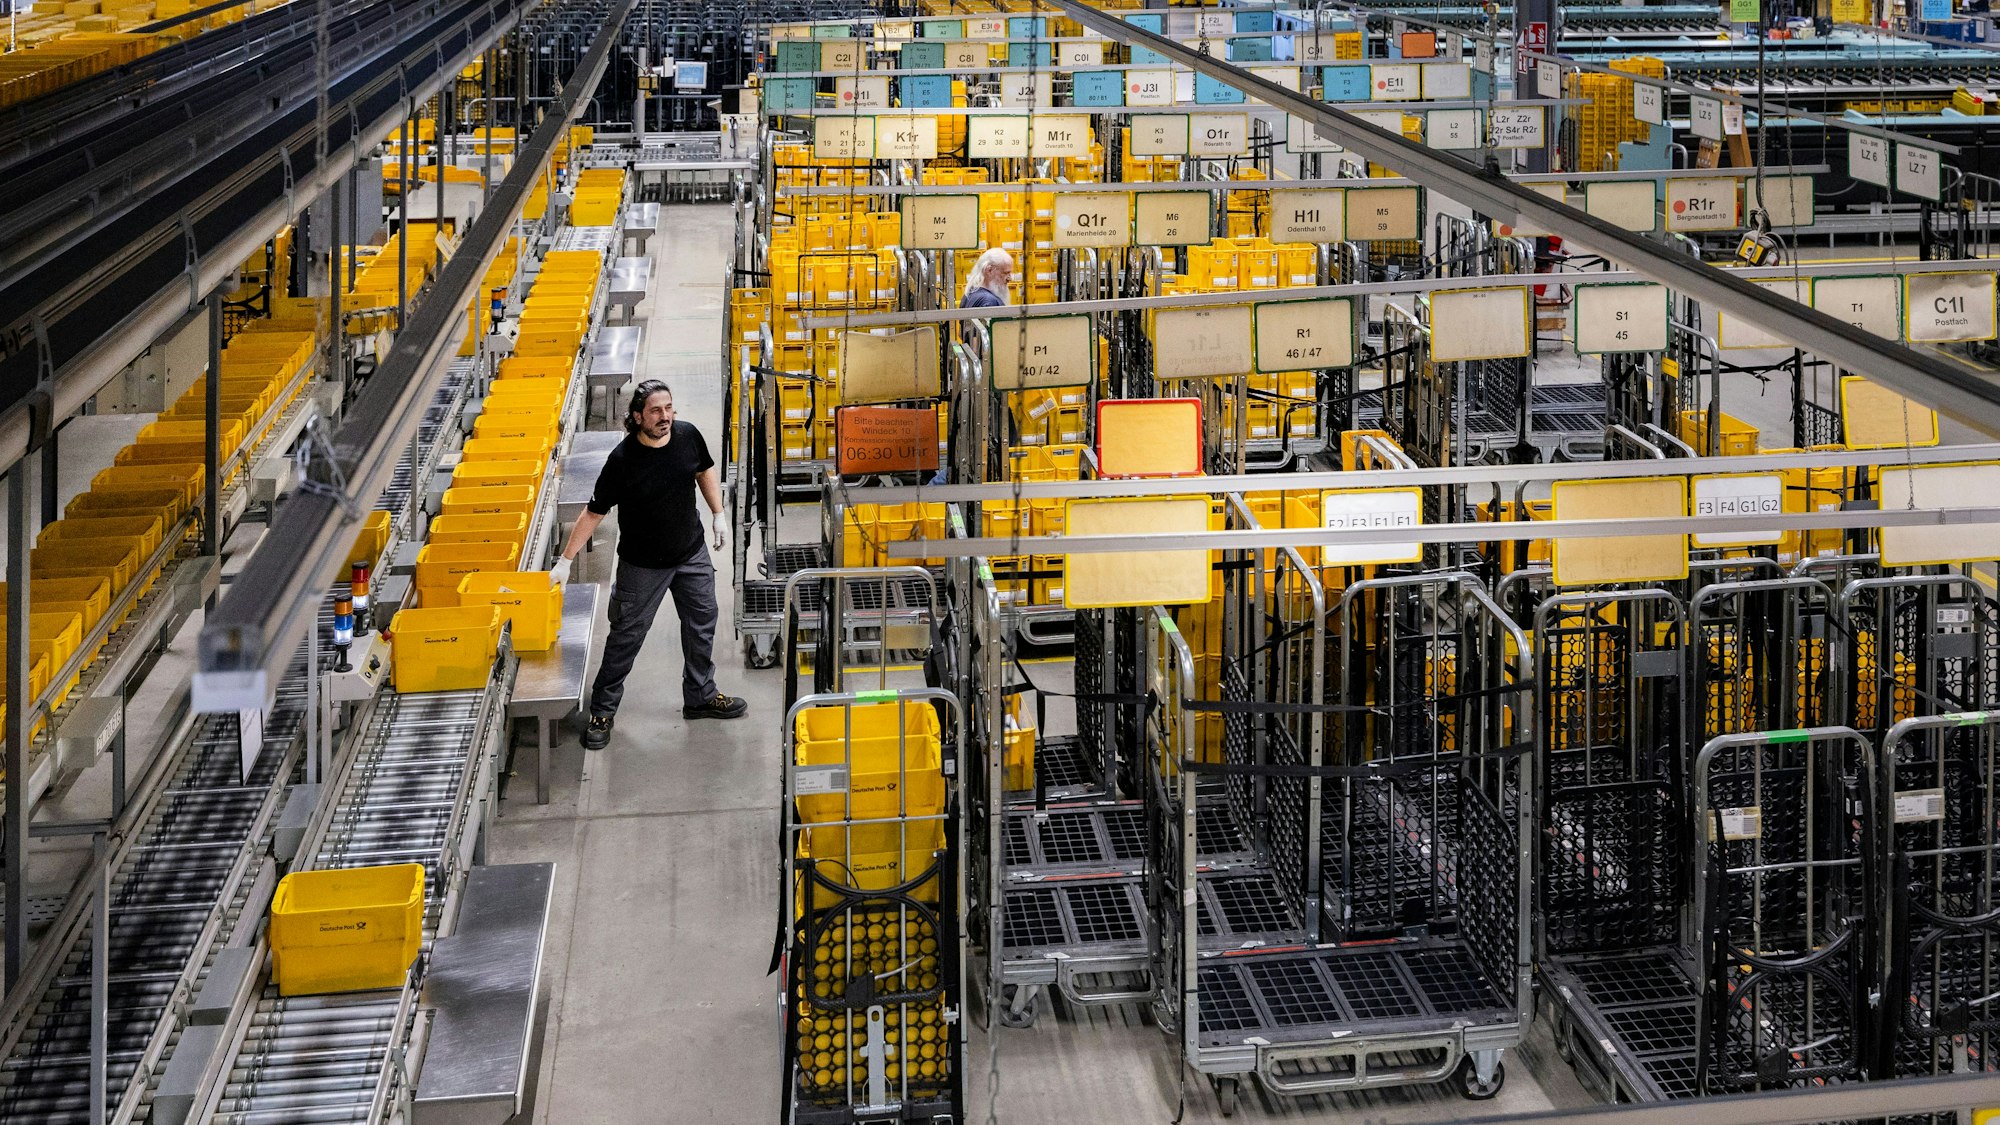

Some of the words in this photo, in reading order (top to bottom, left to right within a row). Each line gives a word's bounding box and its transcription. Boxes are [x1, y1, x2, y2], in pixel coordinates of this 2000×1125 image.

[1699, 110, 1706, 120] LZ
[896, 132, 918, 142] K1r
[1048, 130, 1071, 141] M1r
[1862, 149, 1870, 160] LZ
[1873, 152, 1877, 161] 6
[1910, 161, 1919, 173] LZ
[1922, 164, 1926, 175] 7
[1689, 198, 1715, 211] R1r
[1077, 214, 1107, 228] Q1r
[1167, 228, 1177, 236] 26
[1852, 303, 1863, 312] T1
[1616, 312, 1628, 321] S1
[1935, 318, 1968, 326] Postfach
[1297, 328, 1310, 338] R1
[1616, 331, 1628, 340] 45
[1034, 346, 1048, 355] P1
[1286, 349, 1299, 359] 46
[1302, 349, 1306, 358] /
[1309, 348, 1322, 357] 47
[1022, 367, 1036, 376] 40
[1038, 366, 1044, 376] /
[1046, 365, 1060, 375] 42
[846, 447, 892, 460] 06:30
[899, 446, 928, 458] Uhr
[1699, 502, 1712, 513] F3
[1721, 502, 1734, 513] F4
[1740, 501, 1756, 512] G1
[1762, 500, 1778, 511] G2
